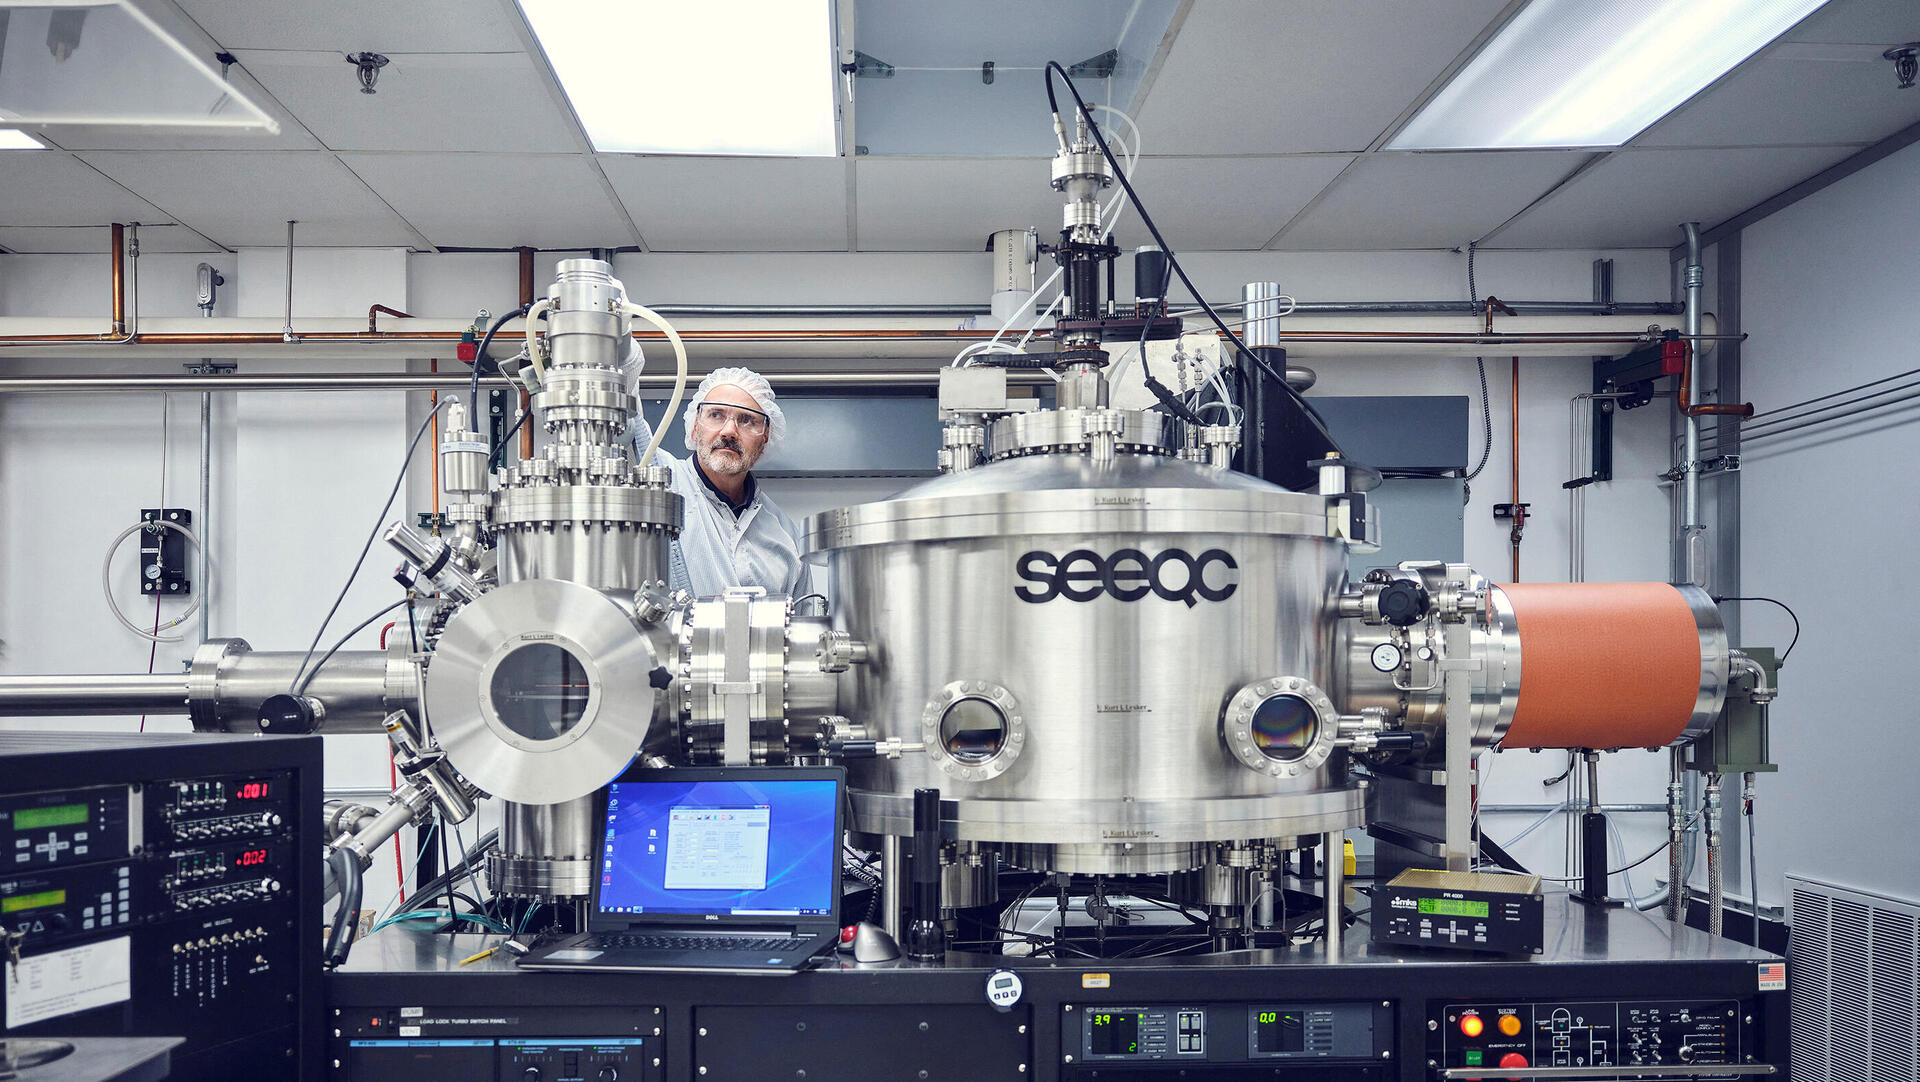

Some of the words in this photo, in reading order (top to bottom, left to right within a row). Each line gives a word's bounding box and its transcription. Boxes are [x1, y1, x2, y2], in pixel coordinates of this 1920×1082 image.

[1095, 1015, 1111, 1025] 3.9
[1259, 1012, 1277, 1023] 0.0
[1129, 1042, 1136, 1052] 2
